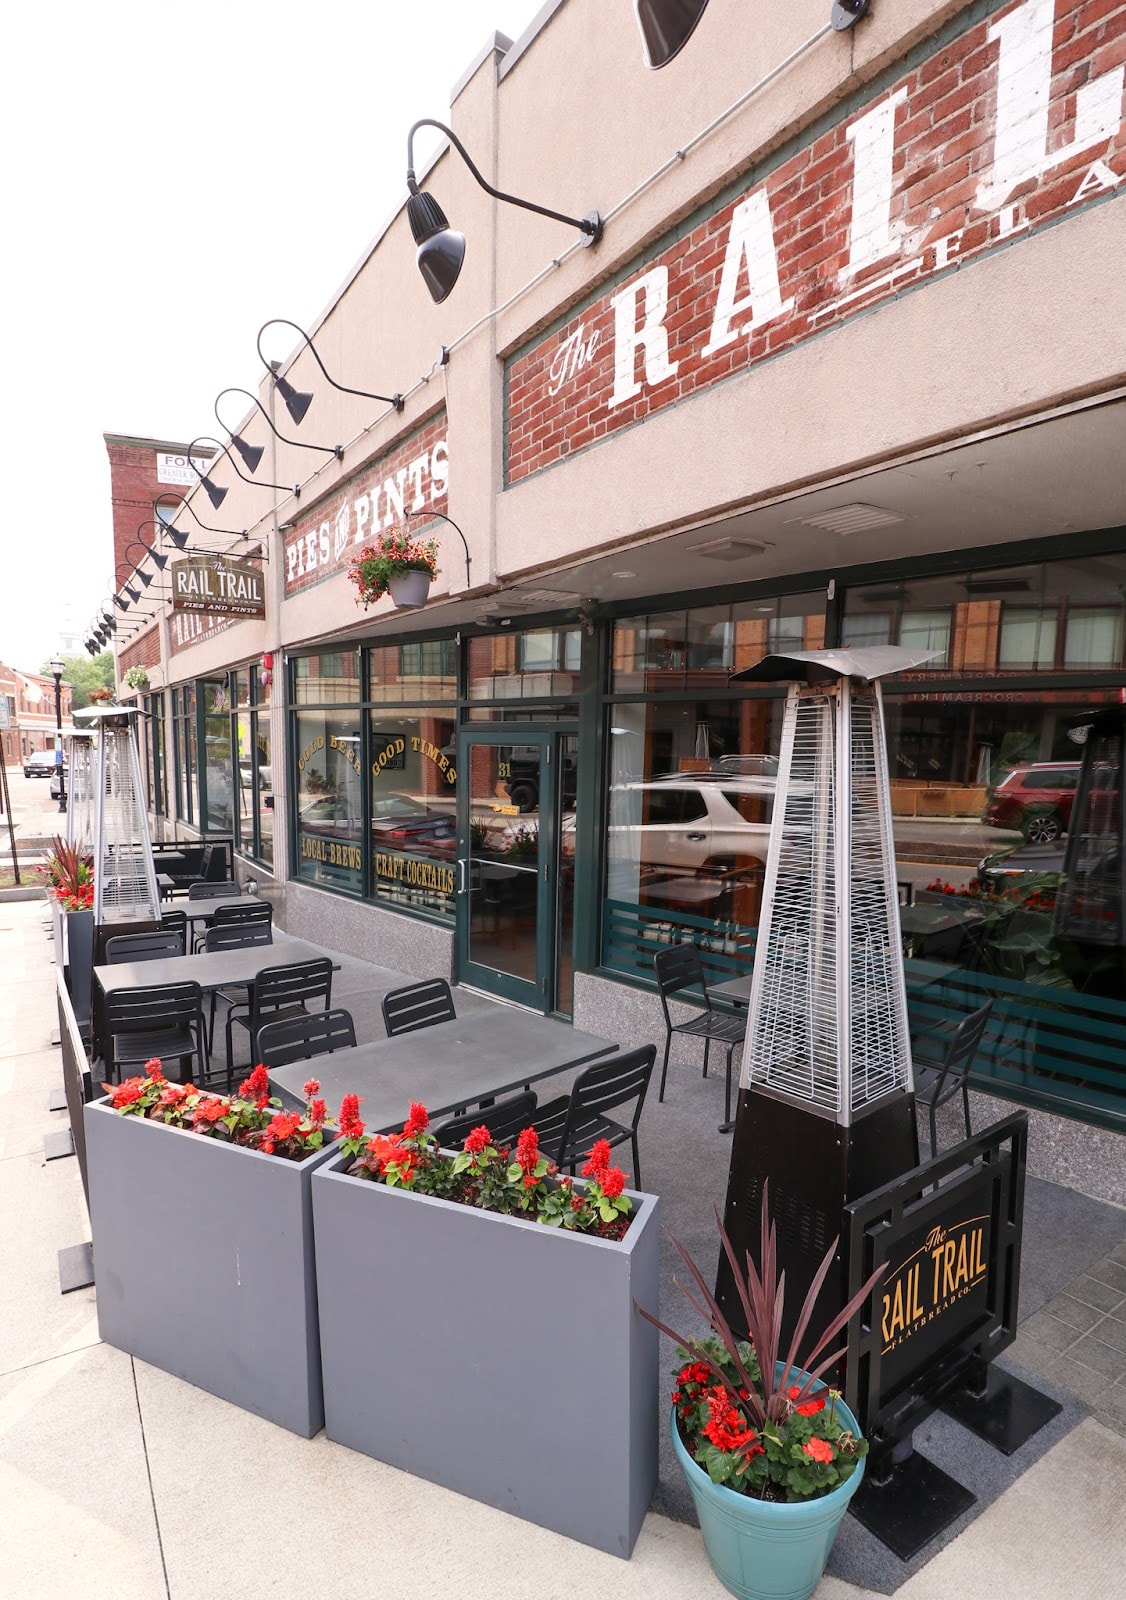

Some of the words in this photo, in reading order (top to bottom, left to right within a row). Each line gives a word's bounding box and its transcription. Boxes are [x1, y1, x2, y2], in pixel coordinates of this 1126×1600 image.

[549, 322, 600, 396] The
[608, 0, 1123, 410] RAIL
[165, 456, 196, 467] FOR
[287, 520, 330, 583] PIES
[334, 505, 349, 557] AND
[354, 440, 448, 544] PINTS
[210, 561, 227, 571] The
[177, 570, 213, 596] RAIL
[217, 571, 261, 600] TRAIL
[299, 736, 324, 771] COLD
[372, 738, 404, 777] GOOD
[411, 736, 457, 784] TIMES
[499, 762, 512, 777] 31
[302, 837, 327, 862] LOCAL
[329, 843, 361, 871] BREWS
[376, 853, 404, 881] CRAFT
[406, 860, 454, 894] COCKTAILS
[925, 1225, 947, 1253] The
[932, 1228, 987, 1305] TRAIL
[891, 1295, 956, 1351] FLATBREAD
[957, 1286, 972, 1298] CO.
